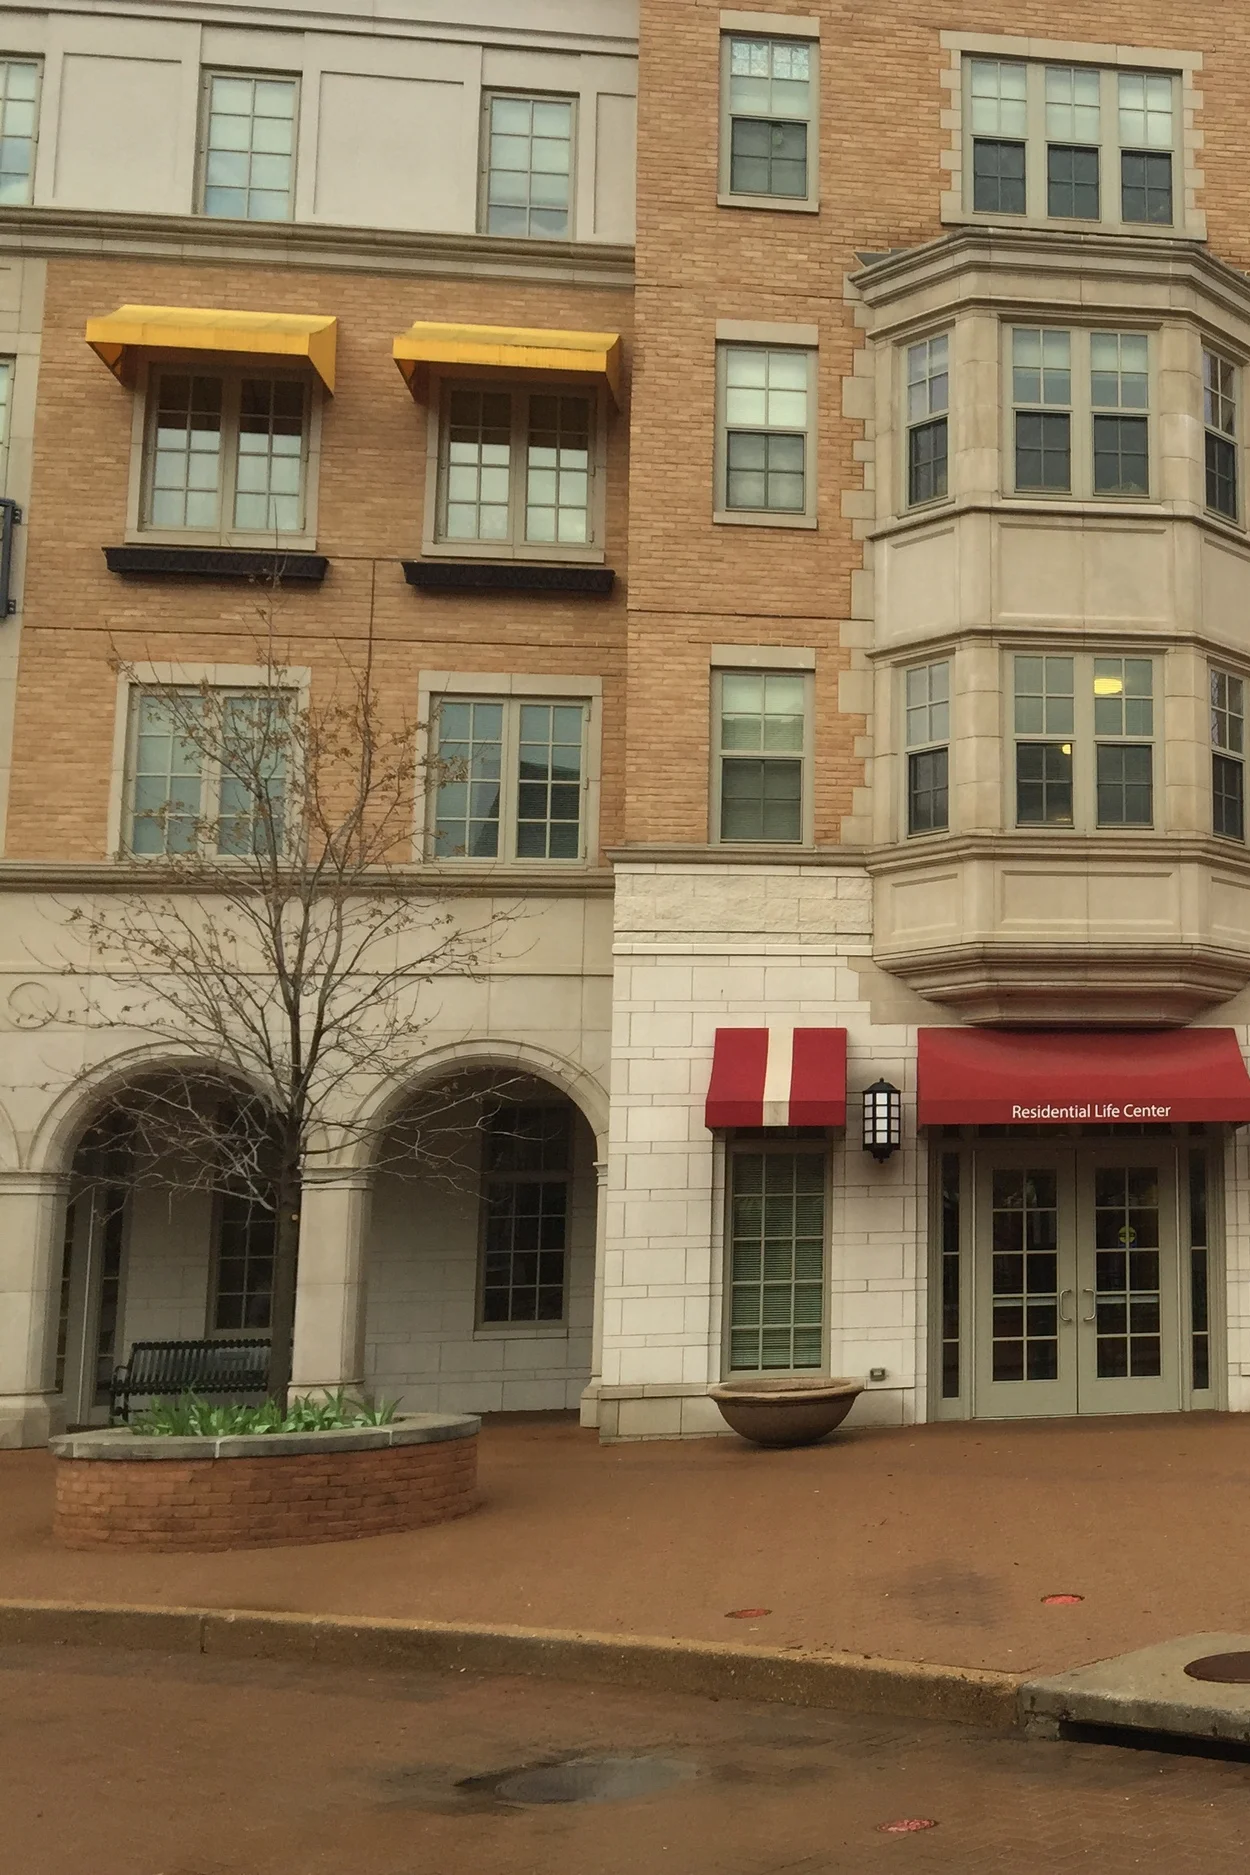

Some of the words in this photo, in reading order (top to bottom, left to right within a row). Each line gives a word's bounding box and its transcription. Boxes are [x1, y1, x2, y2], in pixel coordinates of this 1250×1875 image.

[1012, 1104, 1091, 1119] Residential
[1095, 1104, 1120, 1118] Life
[1123, 1104, 1171, 1118] Center
